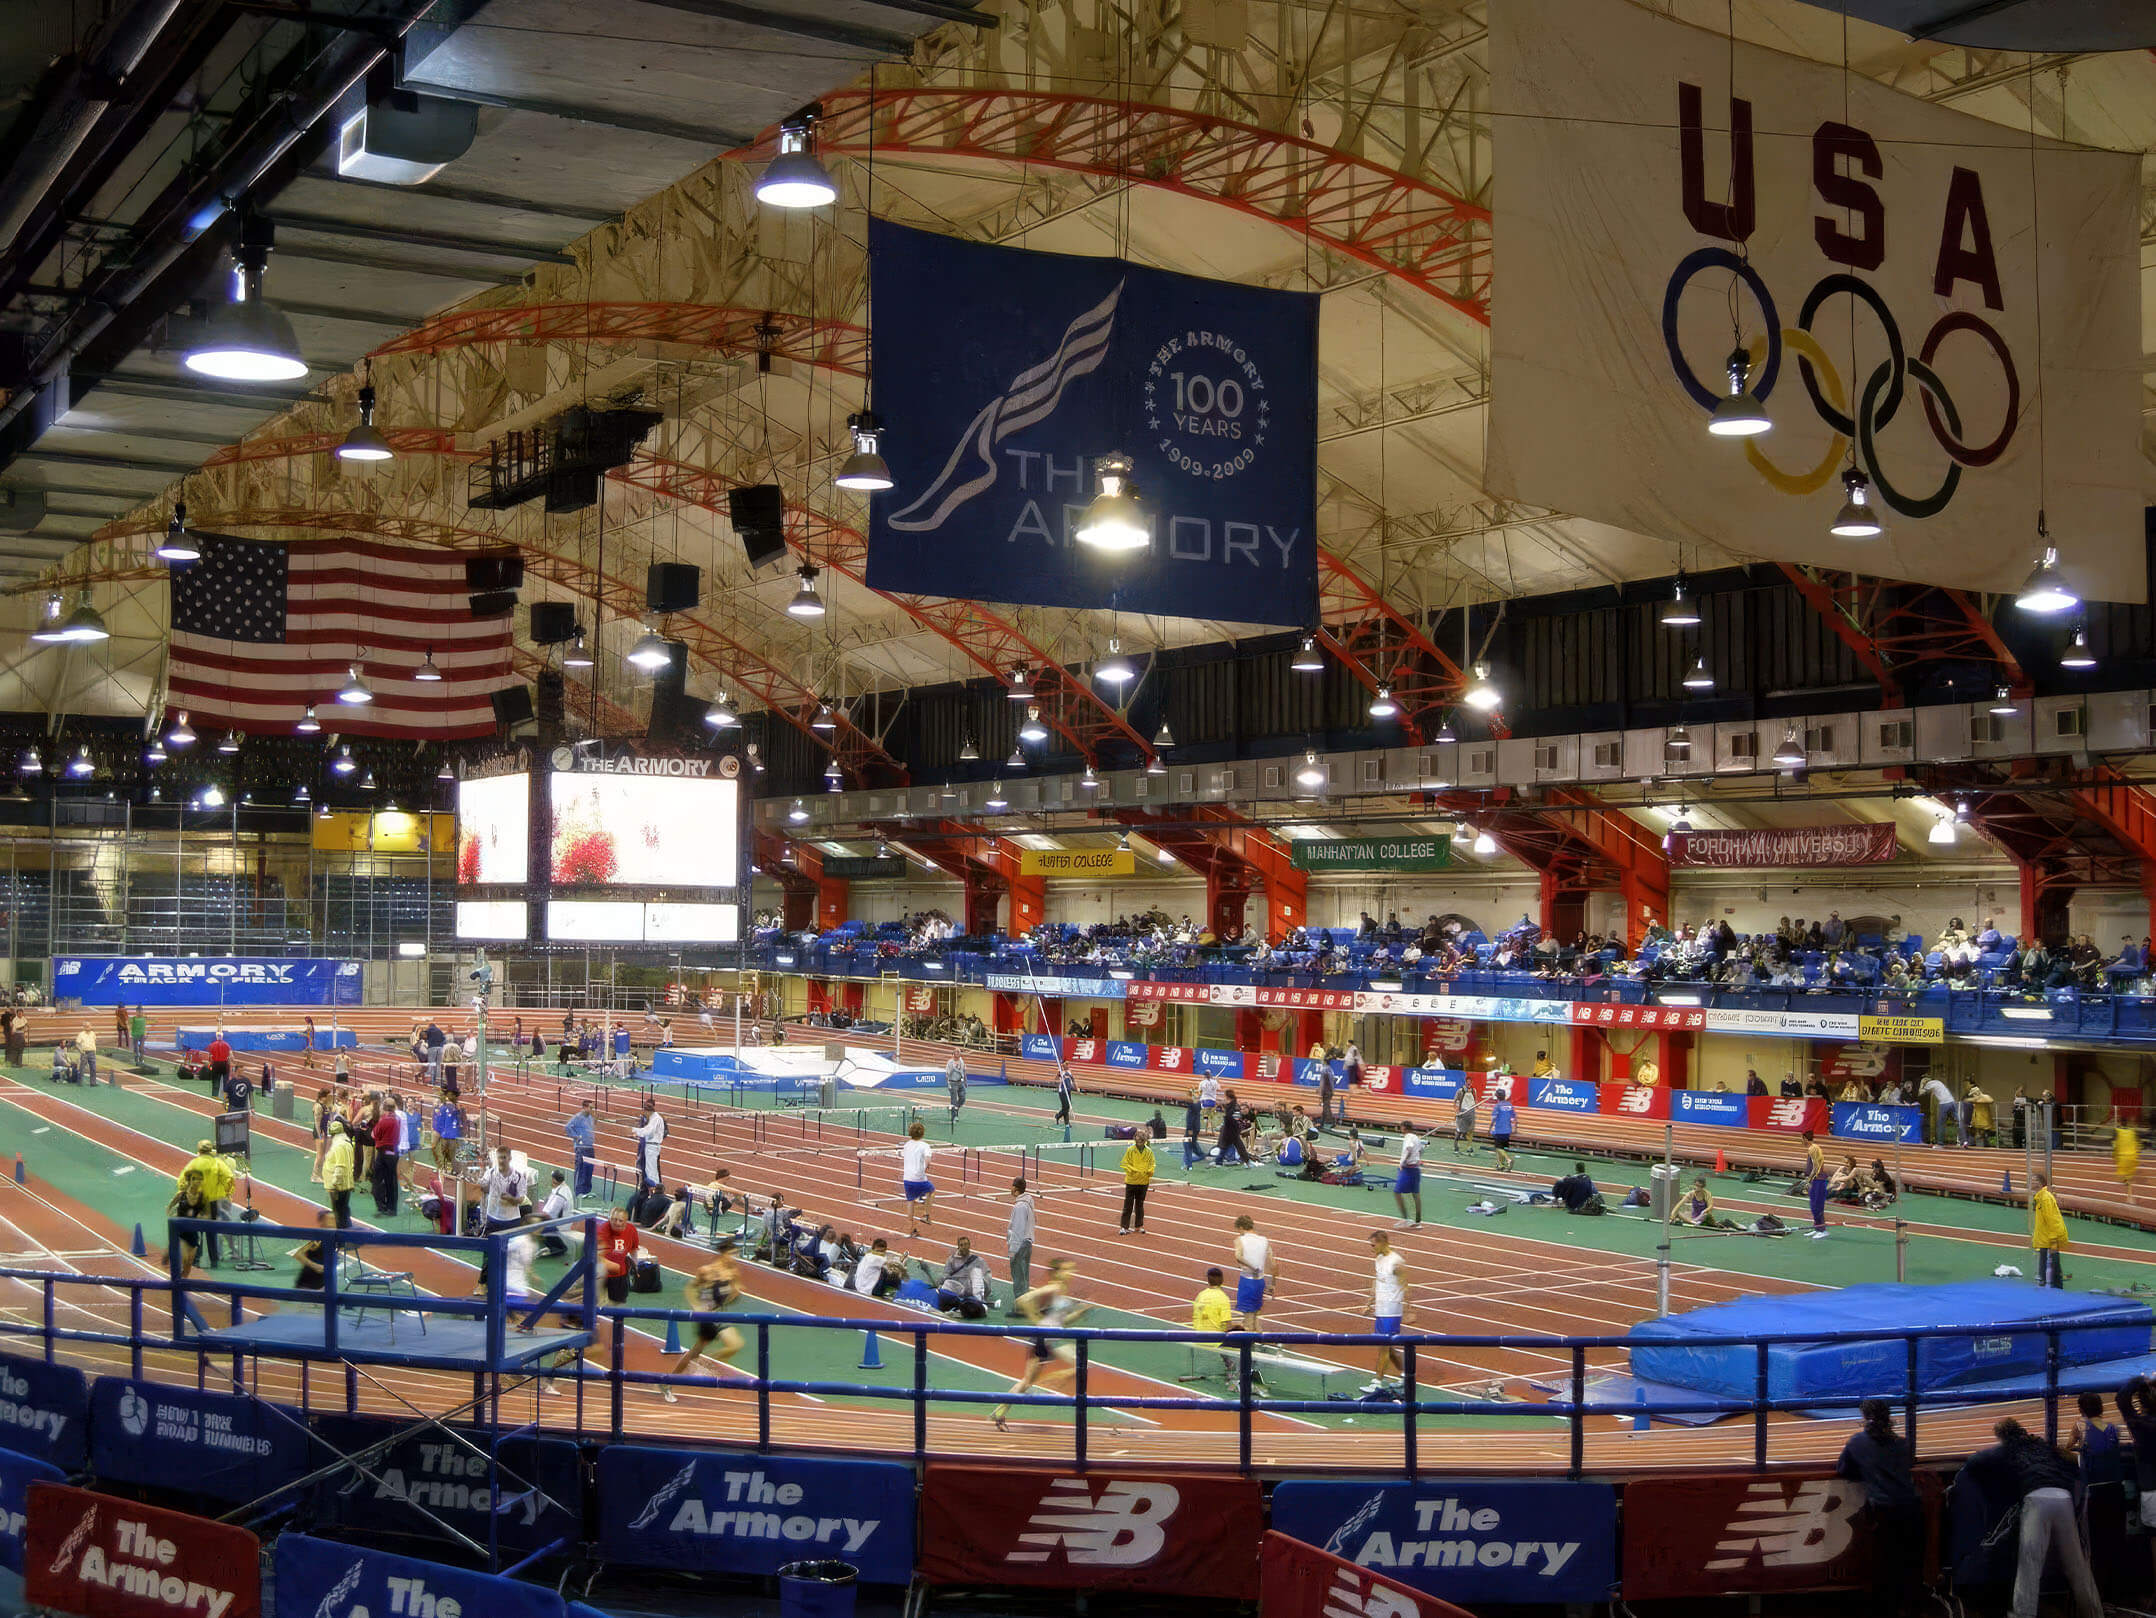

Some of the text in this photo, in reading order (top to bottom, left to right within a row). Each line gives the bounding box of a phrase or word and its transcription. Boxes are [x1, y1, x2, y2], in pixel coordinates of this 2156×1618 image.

[1679, 81, 2004, 311] USA
[1187, 331, 1264, 390] ARMORY
[1170, 372, 1244, 418] 100
[1173, 412, 1241, 439] YEARS
[1005, 449, 1098, 494] TH
[1008, 500, 1300, 569] AORY
[581, 755, 712, 777] THE ARMORY
[1307, 842, 1436, 861] MANHATTAN COLLEGE
[118, 964, 295, 978] ARMORY
[1867, 1110, 1890, 1122] The
[0, 1400, 69, 1441] mory
[419, 1443, 489, 1478] The
[724, 1471, 804, 1506] The
[668, 1499, 881, 1552] Armory
[1415, 1498, 1500, 1532] The
[115, 1518, 178, 1566] The
[1351, 1531, 1582, 1576] Armory
[78, 1544, 236, 1618] Armory
[387, 1575, 462, 1618] The
